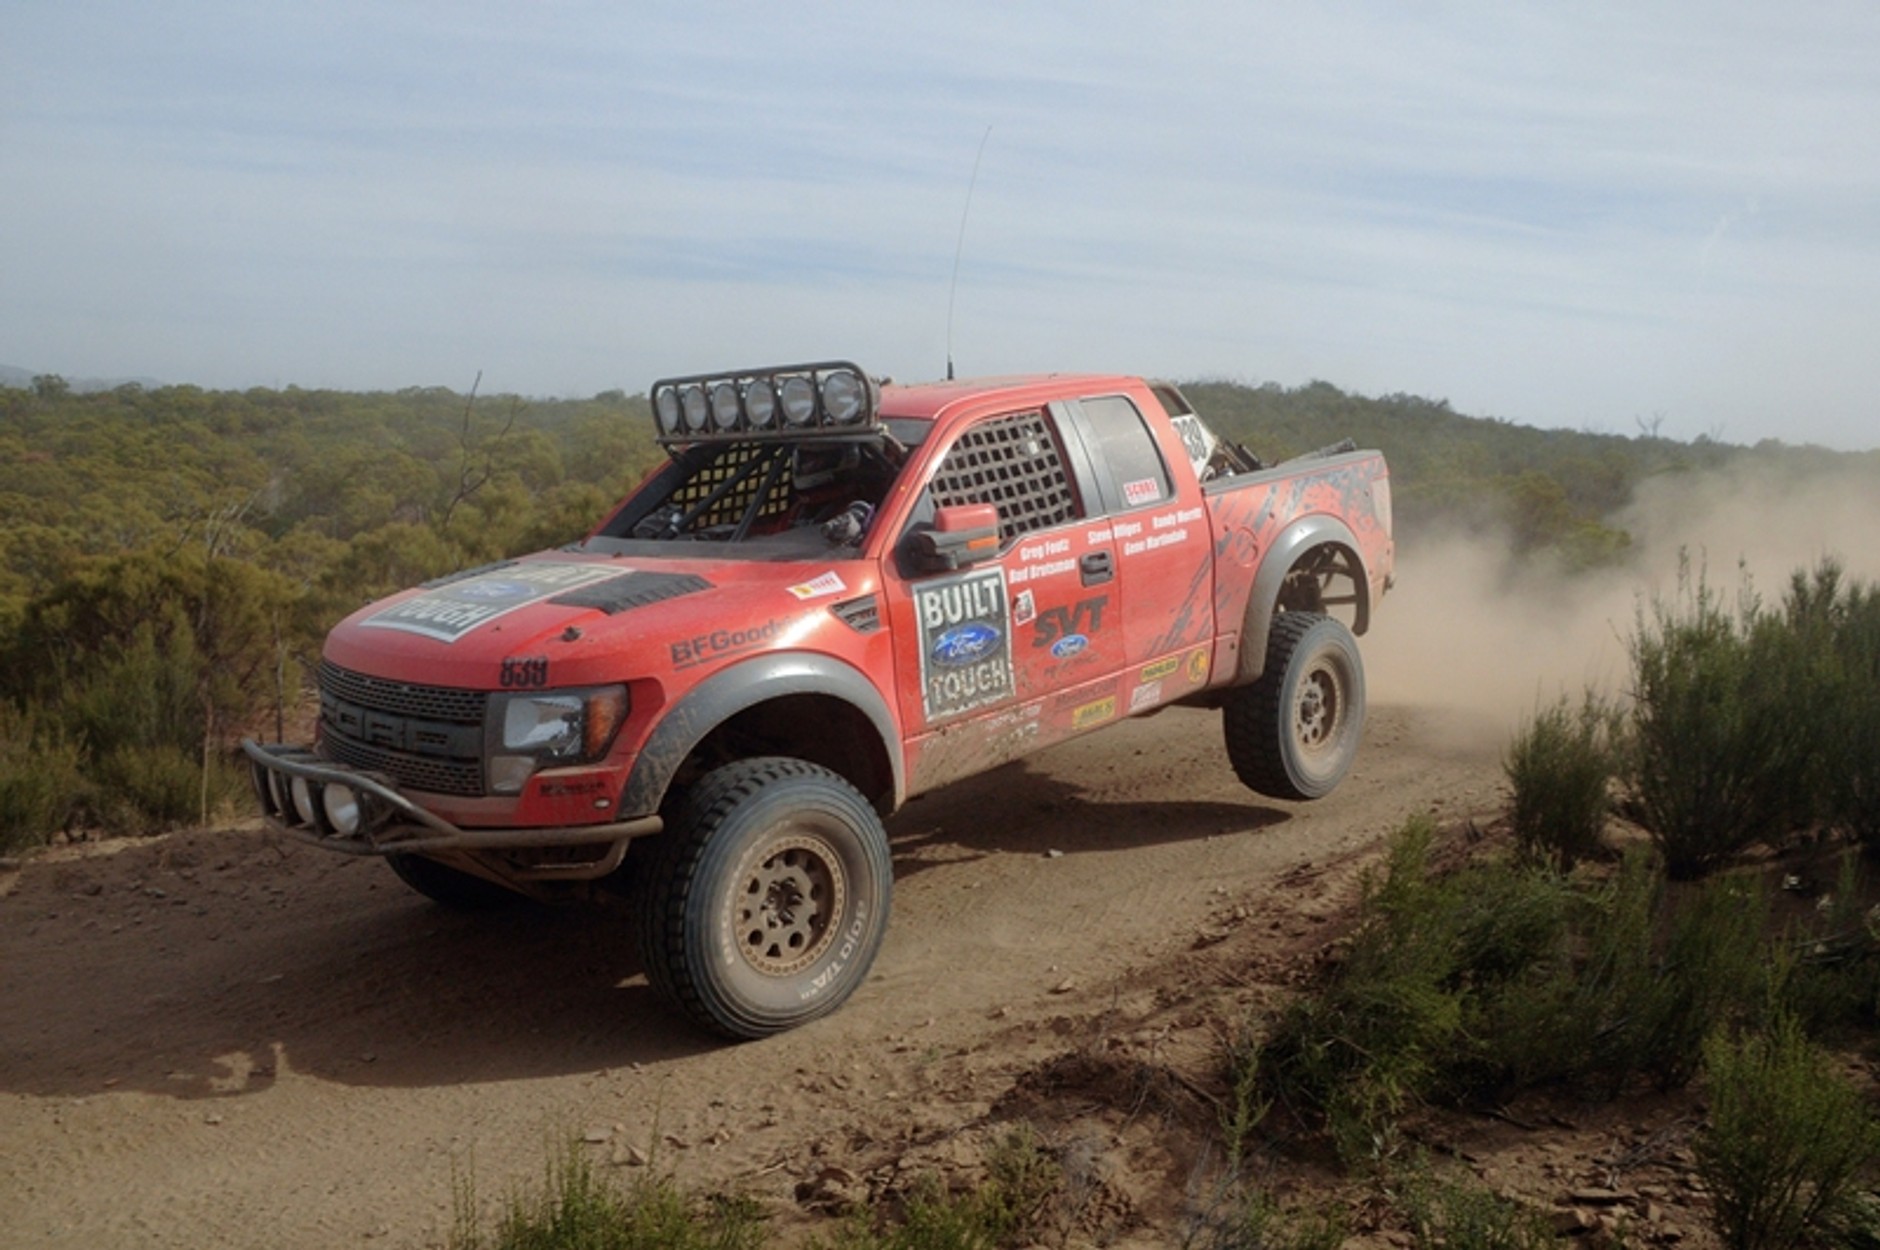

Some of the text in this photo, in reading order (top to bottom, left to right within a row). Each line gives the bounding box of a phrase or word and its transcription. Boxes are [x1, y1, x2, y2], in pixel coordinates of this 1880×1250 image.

[1173, 418, 1207, 461] 39
[923, 577, 1000, 629] BUILT
[1033, 595, 1108, 649] SVT
[930, 658, 1007, 705] TOUGH
